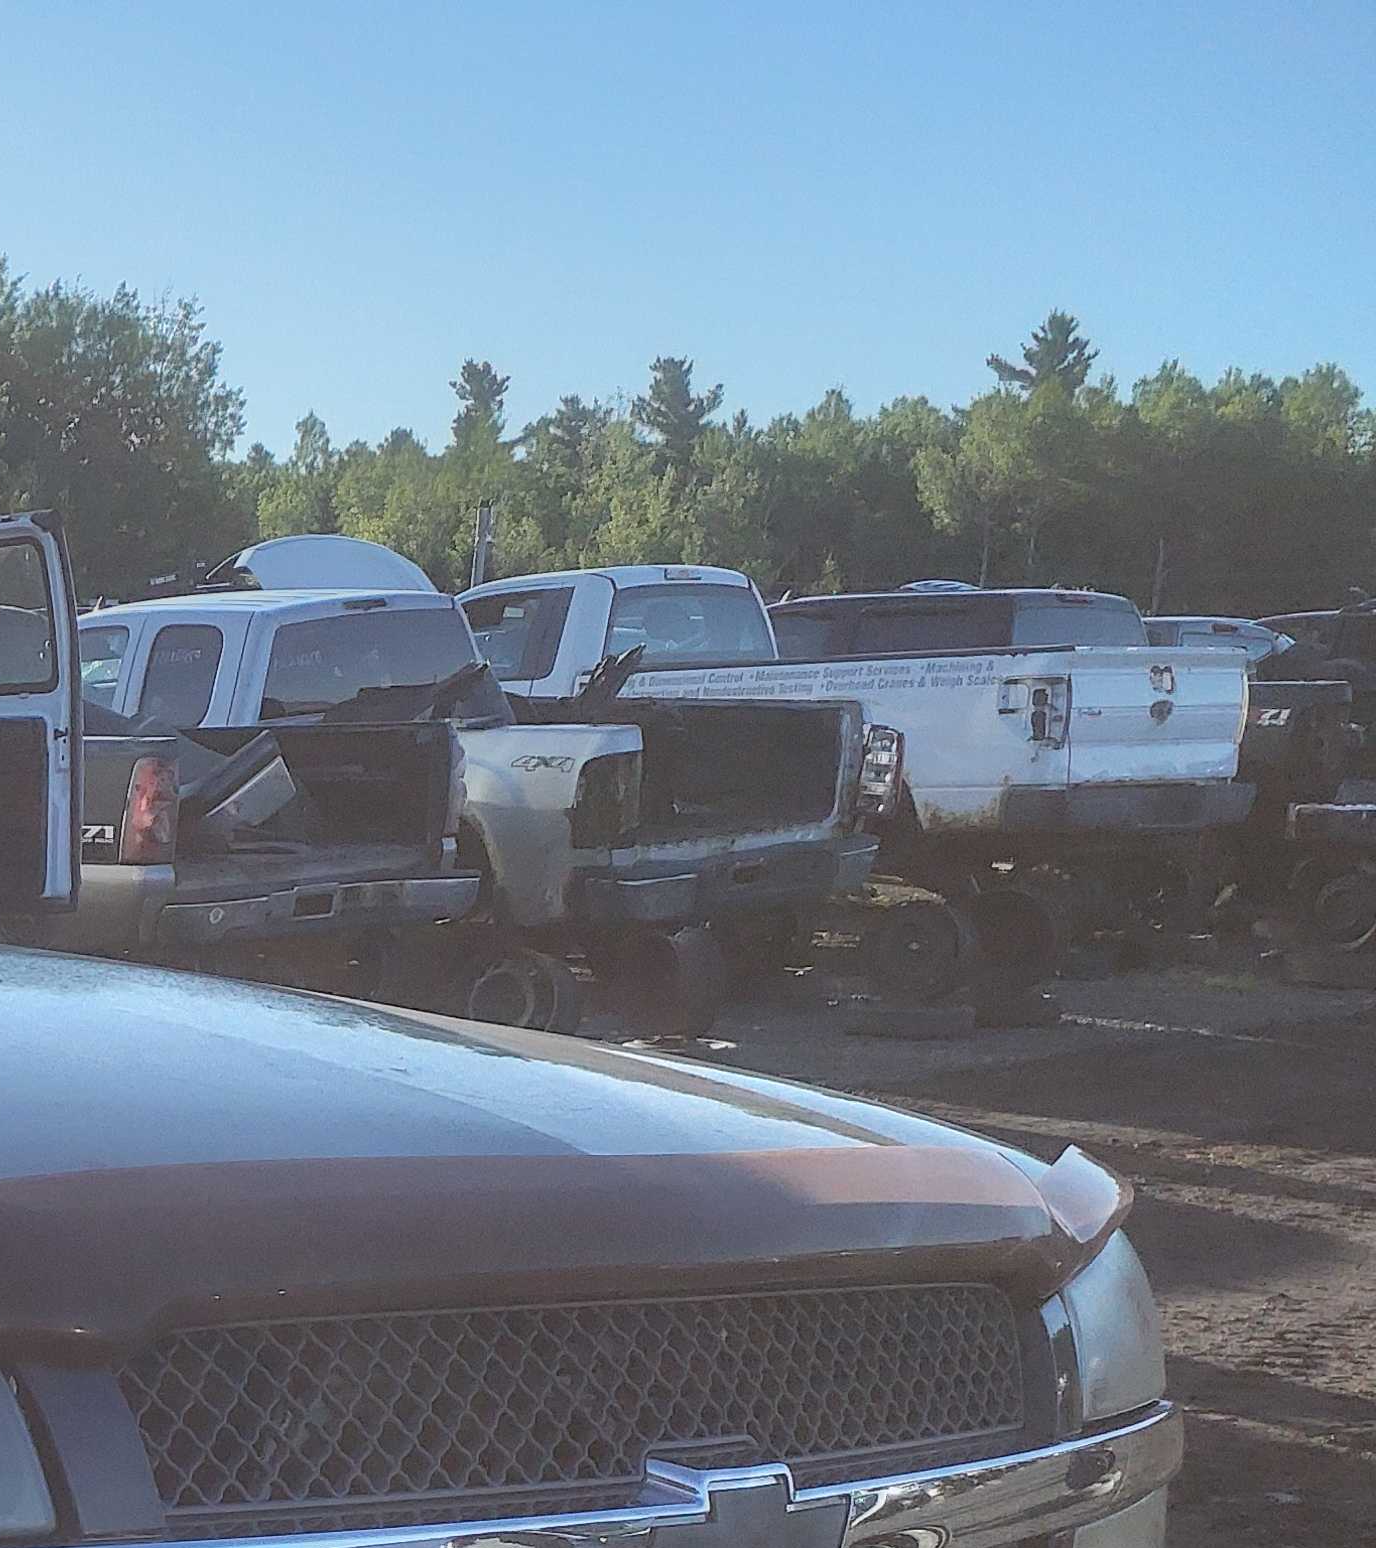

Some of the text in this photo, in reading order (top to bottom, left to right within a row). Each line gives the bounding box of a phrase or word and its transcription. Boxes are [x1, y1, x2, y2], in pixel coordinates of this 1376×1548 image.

[709, 672, 744, 684] Control
[823, 666, 864, 679] Support
[867, 664, 911, 677] Services
[986, 660, 995, 672] &
[779, 683, 814, 696] Testing
[879, 678, 913, 690] Cranes
[918, 676, 926, 688] &
